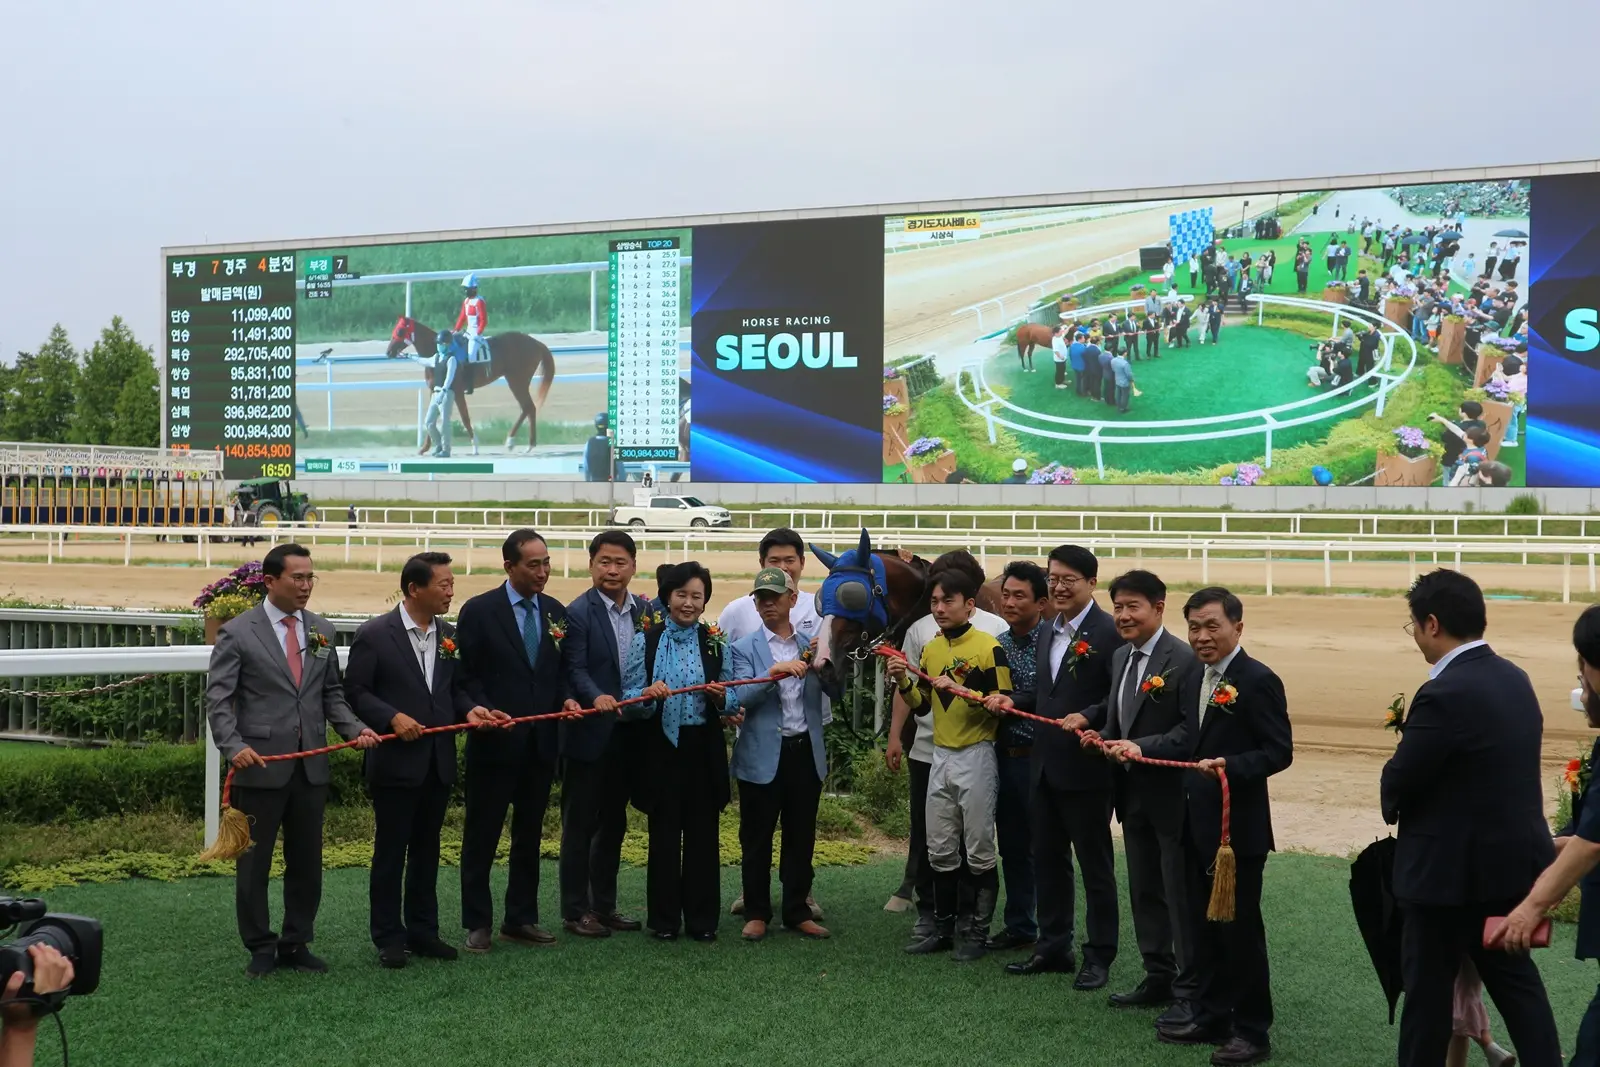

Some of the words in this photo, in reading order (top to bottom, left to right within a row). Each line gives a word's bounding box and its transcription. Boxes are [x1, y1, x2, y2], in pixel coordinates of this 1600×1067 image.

[908, 217, 964, 230] 경기도지사배
[931, 232, 954, 240] 시상식
[662, 240, 672, 248] 20
[172, 261, 196, 278] 부경
[212, 260, 220, 274] 7
[223, 258, 247, 276] 경주
[258, 258, 266, 272] 4
[269, 256, 294, 272] 분전
[310, 260, 328, 272] 부경
[336, 259, 344, 270] 7
[201, 285, 262, 302] 발매금액(원)
[171, 310, 190, 323] 단승
[231, 306, 292, 323] 11,099,400
[742, 318, 780, 327] HORSE
[786, 316, 830, 326] RACING
[171, 329, 190, 342] 연승
[231, 326, 292, 342] 11,491,300
[171, 348, 190, 361] 복승
[224, 346, 292, 362] 292,705,400
[716, 332, 858, 370] SEOUL
[171, 367, 190, 380] 쌍승
[230, 366, 292, 381] 95,831,100
[171, 386, 190, 399] 복연
[230, 385, 292, 400] 31,781,200
[171, 406, 190, 419] 삼복
[224, 404, 292, 420] 396,962,200
[171, 424, 190, 438] 삼쌍
[224, 424, 292, 440] 300,984,300
[46, 449, 61, 458] With
[215, 444, 292, 459] 1140,854,900
[622, 449, 676, 458] 300,984,300원
[262, 464, 292, 477] 16:50
[338, 462, 355, 470] 4:55
